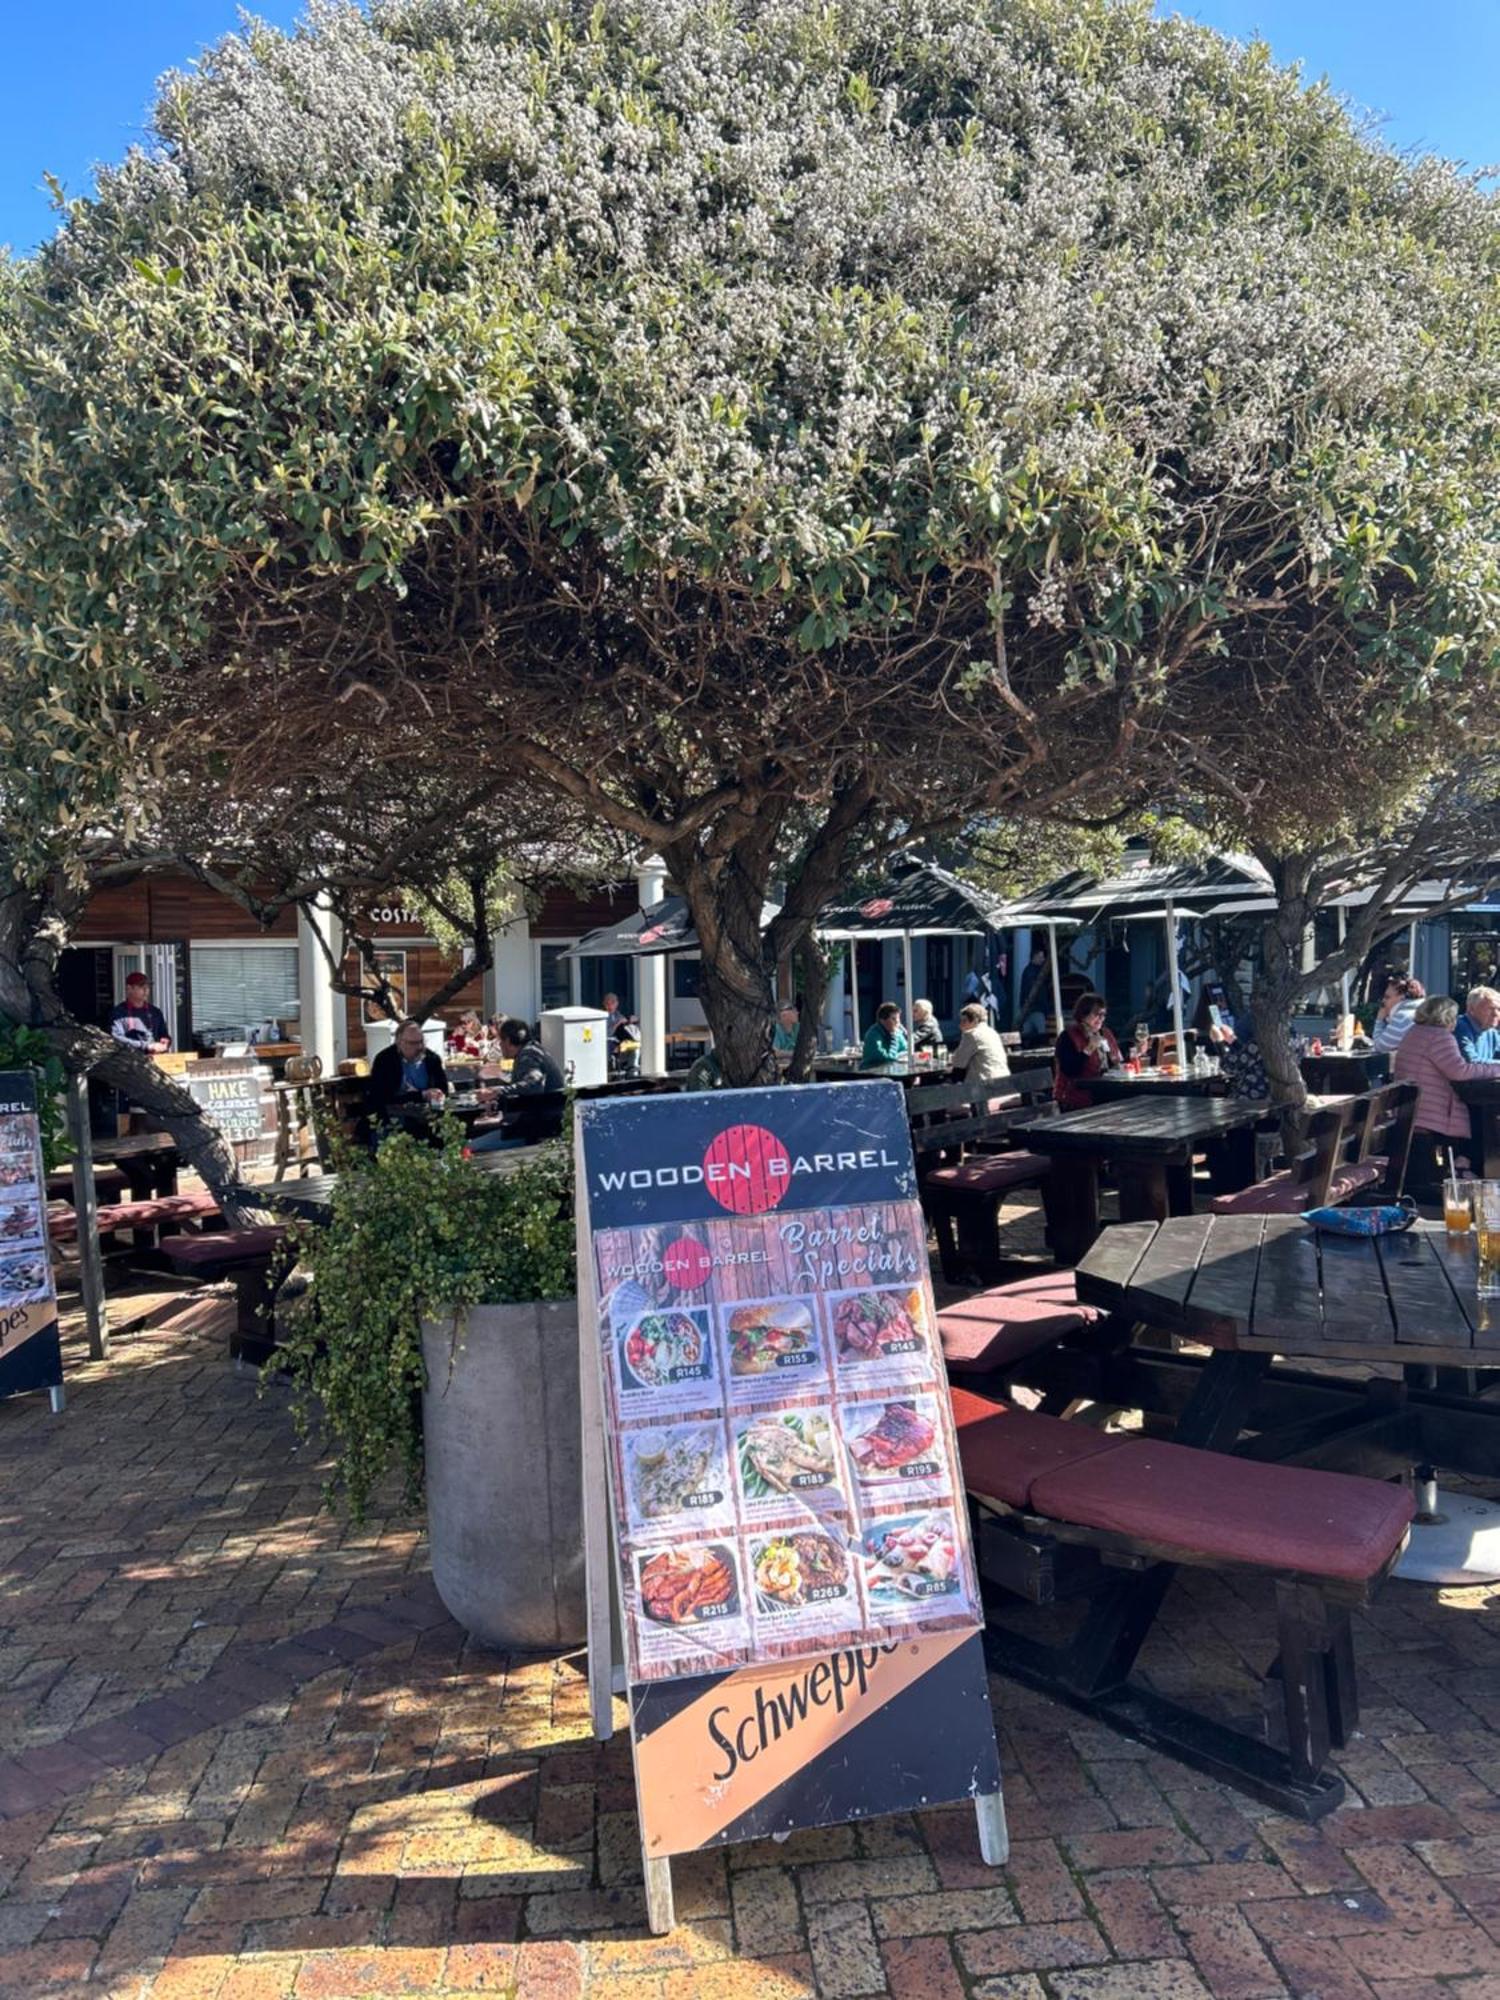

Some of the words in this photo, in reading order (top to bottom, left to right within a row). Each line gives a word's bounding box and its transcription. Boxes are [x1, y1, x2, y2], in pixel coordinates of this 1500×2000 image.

[371, 907, 419, 924] COSTA
[208, 1081, 250, 1100] HAKE
[599, 1161, 750, 1192] WOODEN
[768, 1150, 898, 1177] BARREL
[780, 1214, 882, 1254] Barrel
[607, 1258, 690, 1276] WOODEN
[699, 1250, 774, 1268] BARREL
[797, 1249, 917, 1290] Specials
[890, 1340, 916, 1352] R145
[783, 1354, 808, 1365] R155
[676, 1366, 702, 1379] R145
[812, 1585, 840, 1600] R265
[702, 1605, 728, 1618] R215
[707, 1643, 898, 1781] Schwepp
